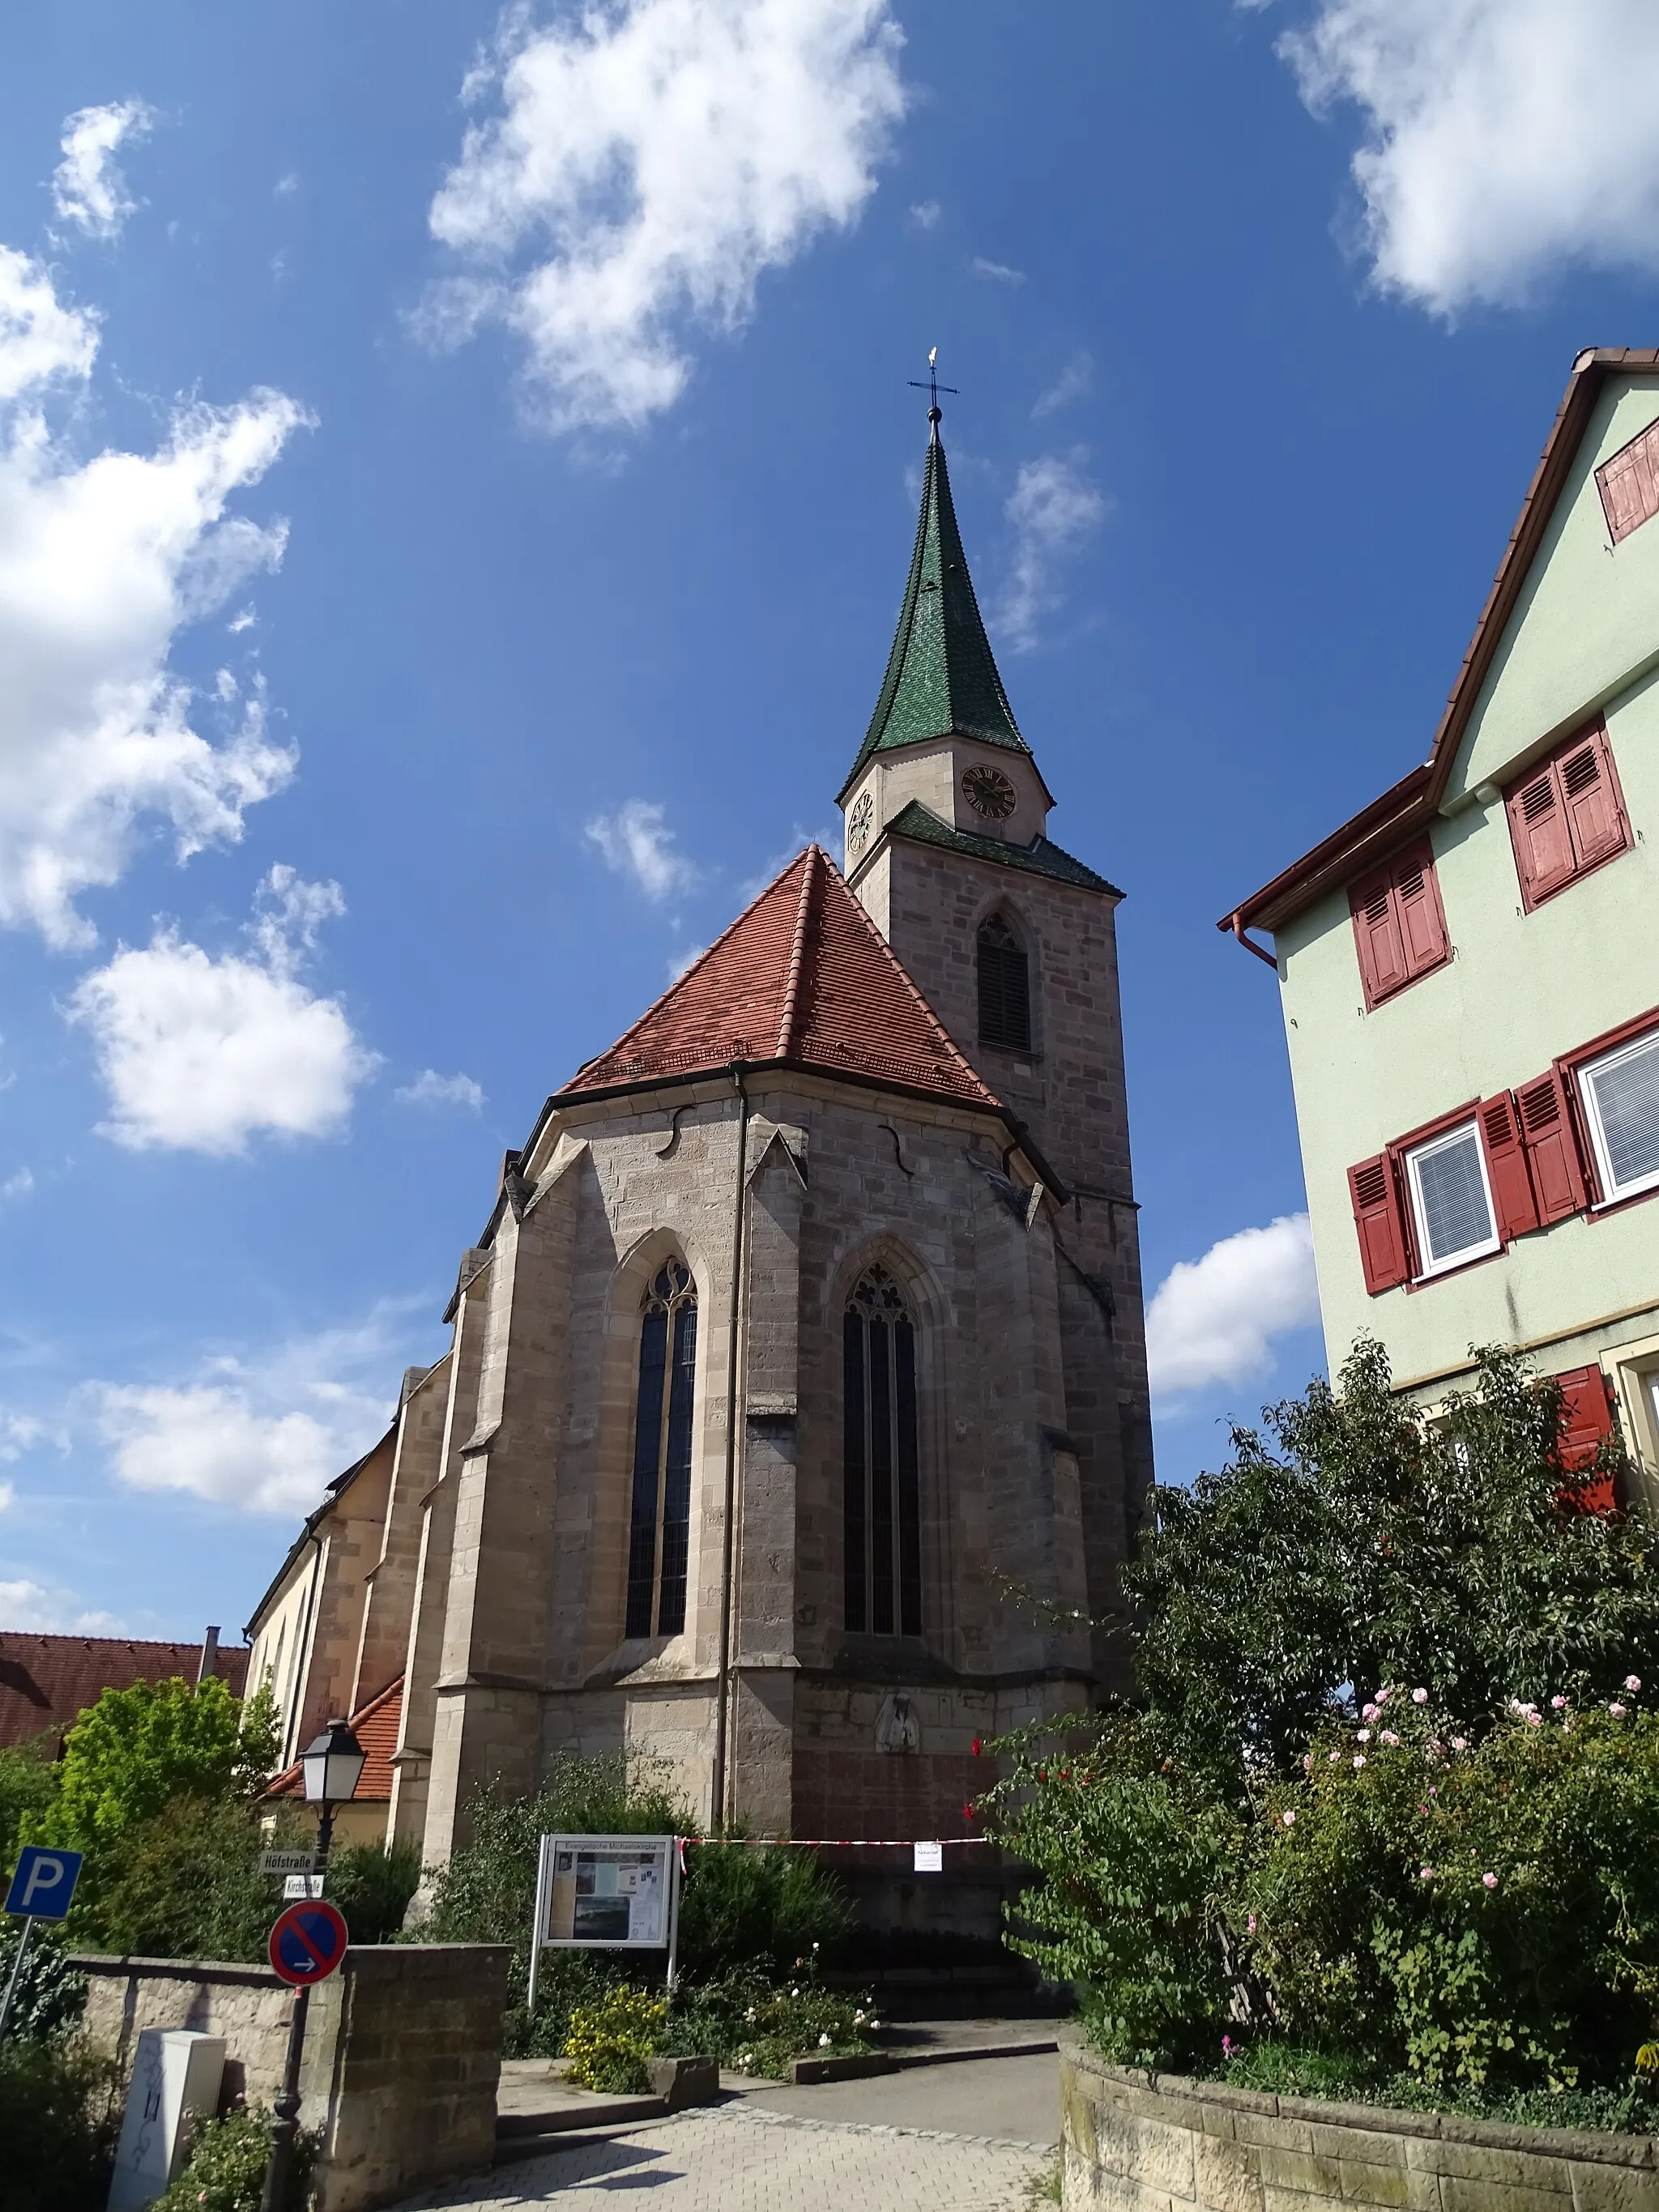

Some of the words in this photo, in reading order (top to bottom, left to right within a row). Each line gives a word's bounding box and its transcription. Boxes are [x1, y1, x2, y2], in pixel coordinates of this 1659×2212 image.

[983, 769, 993, 779] XII
[565, 1842, 608, 1851] Evangelische
[609, 1843, 657, 1851] Michaelskirche
[265, 1854, 311, 1869] Höfstraße
[22, 1856, 64, 1907] P
[287, 1879, 321, 1893] Kirchstraße
